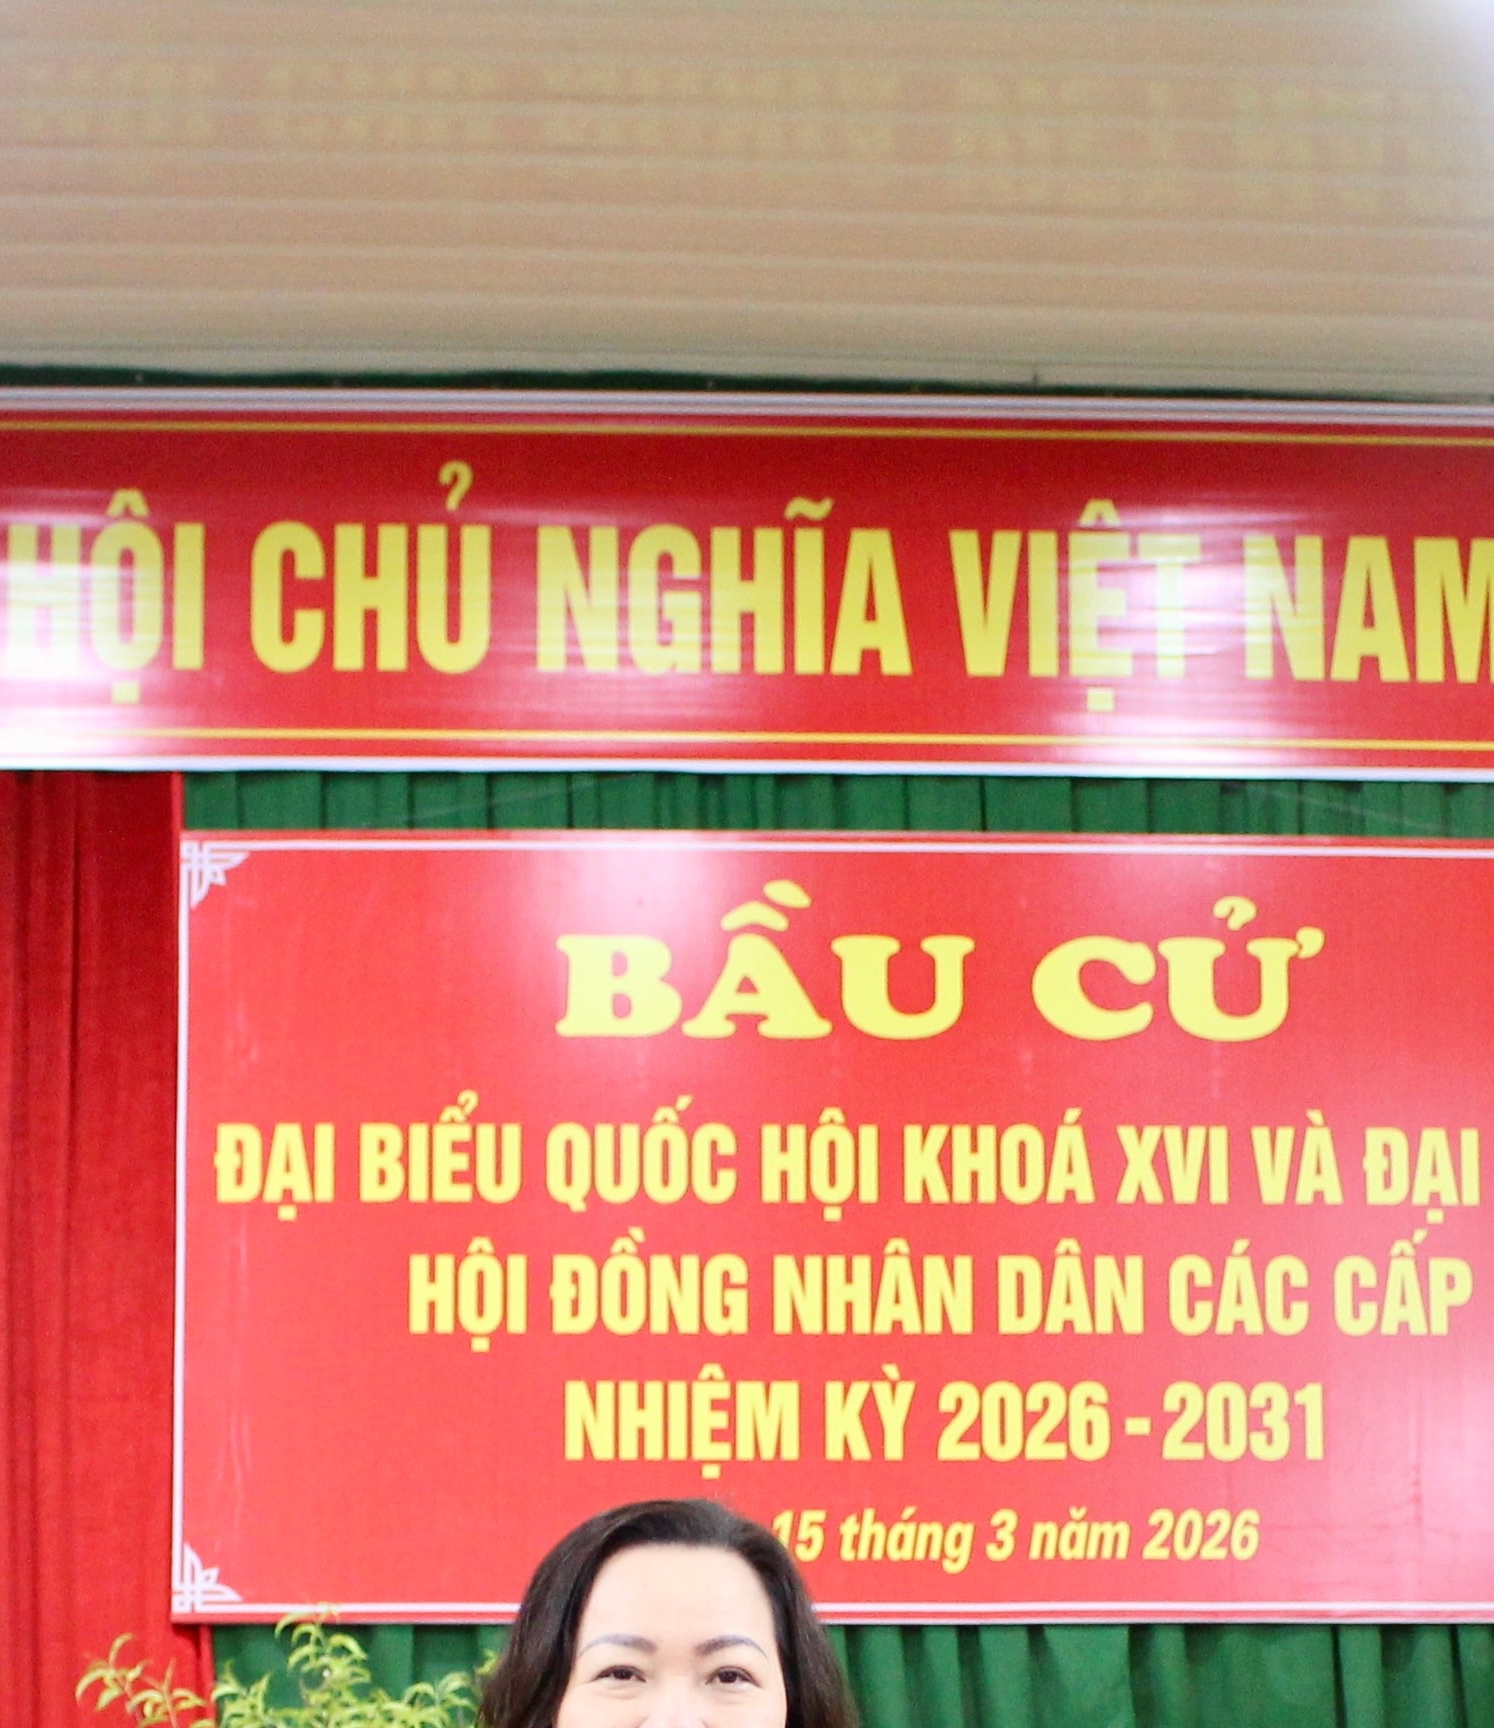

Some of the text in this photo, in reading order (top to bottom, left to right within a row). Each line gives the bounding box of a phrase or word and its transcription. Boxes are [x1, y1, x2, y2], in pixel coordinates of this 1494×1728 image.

[7, 490, 205, 704] HỘI
[250, 461, 493, 674] CHỦ
[536, 498, 913, 675] NGHĨA
[949, 499, 1202, 712] VIỆT
[555, 879, 1325, 1042] BẦU CỬ
[214, 1122, 335, 1220] ĐẠI
[359, 1090, 522, 1204] BIỂU
[546, 1095, 737, 1211] QUỐC
[761, 1107, 879, 1221] HỘI
[903, 1108, 1095, 1204] KHOÁ
[1117, 1125, 1228, 1204] XVI
[1251, 1110, 1343, 1205] VÀ
[1362, 1127, 1480, 1223] ĐẠI
[409, 1227, 1473, 1352] HỘI ĐỒNG NHÂN DÂN CÁC CẤP
[565, 1363, 800, 1479] NHIỆM
[825, 1364, 915, 1461] KỲ
[772, 1506, 1260, 1574] 15 tháng 3 năm 2026
